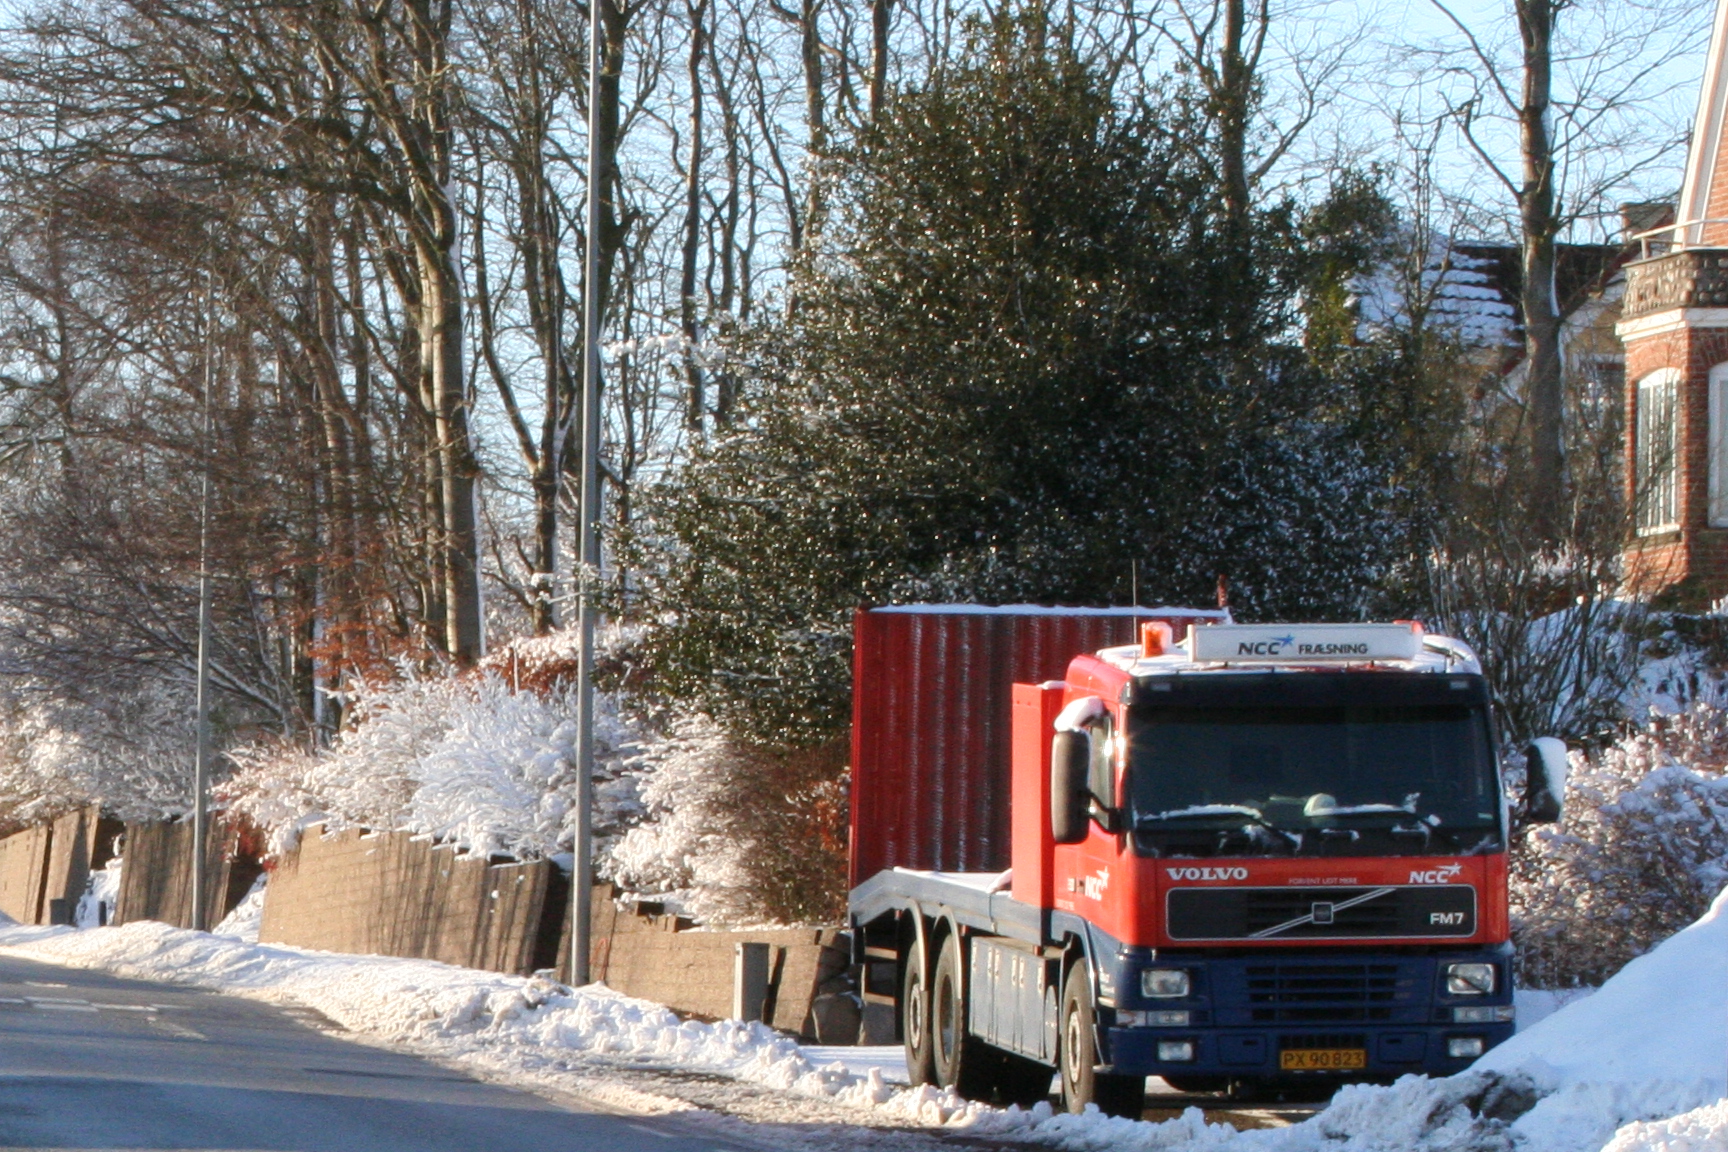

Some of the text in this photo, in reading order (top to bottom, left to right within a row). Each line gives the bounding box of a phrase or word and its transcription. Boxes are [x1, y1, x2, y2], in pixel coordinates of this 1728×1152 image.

[1238, 641, 1369, 655] NCC FRÆSNING
[1165, 866, 1249, 881] VOLVO
[1409, 870, 1451, 884] NCC
[1430, 912, 1465, 925] FM7
